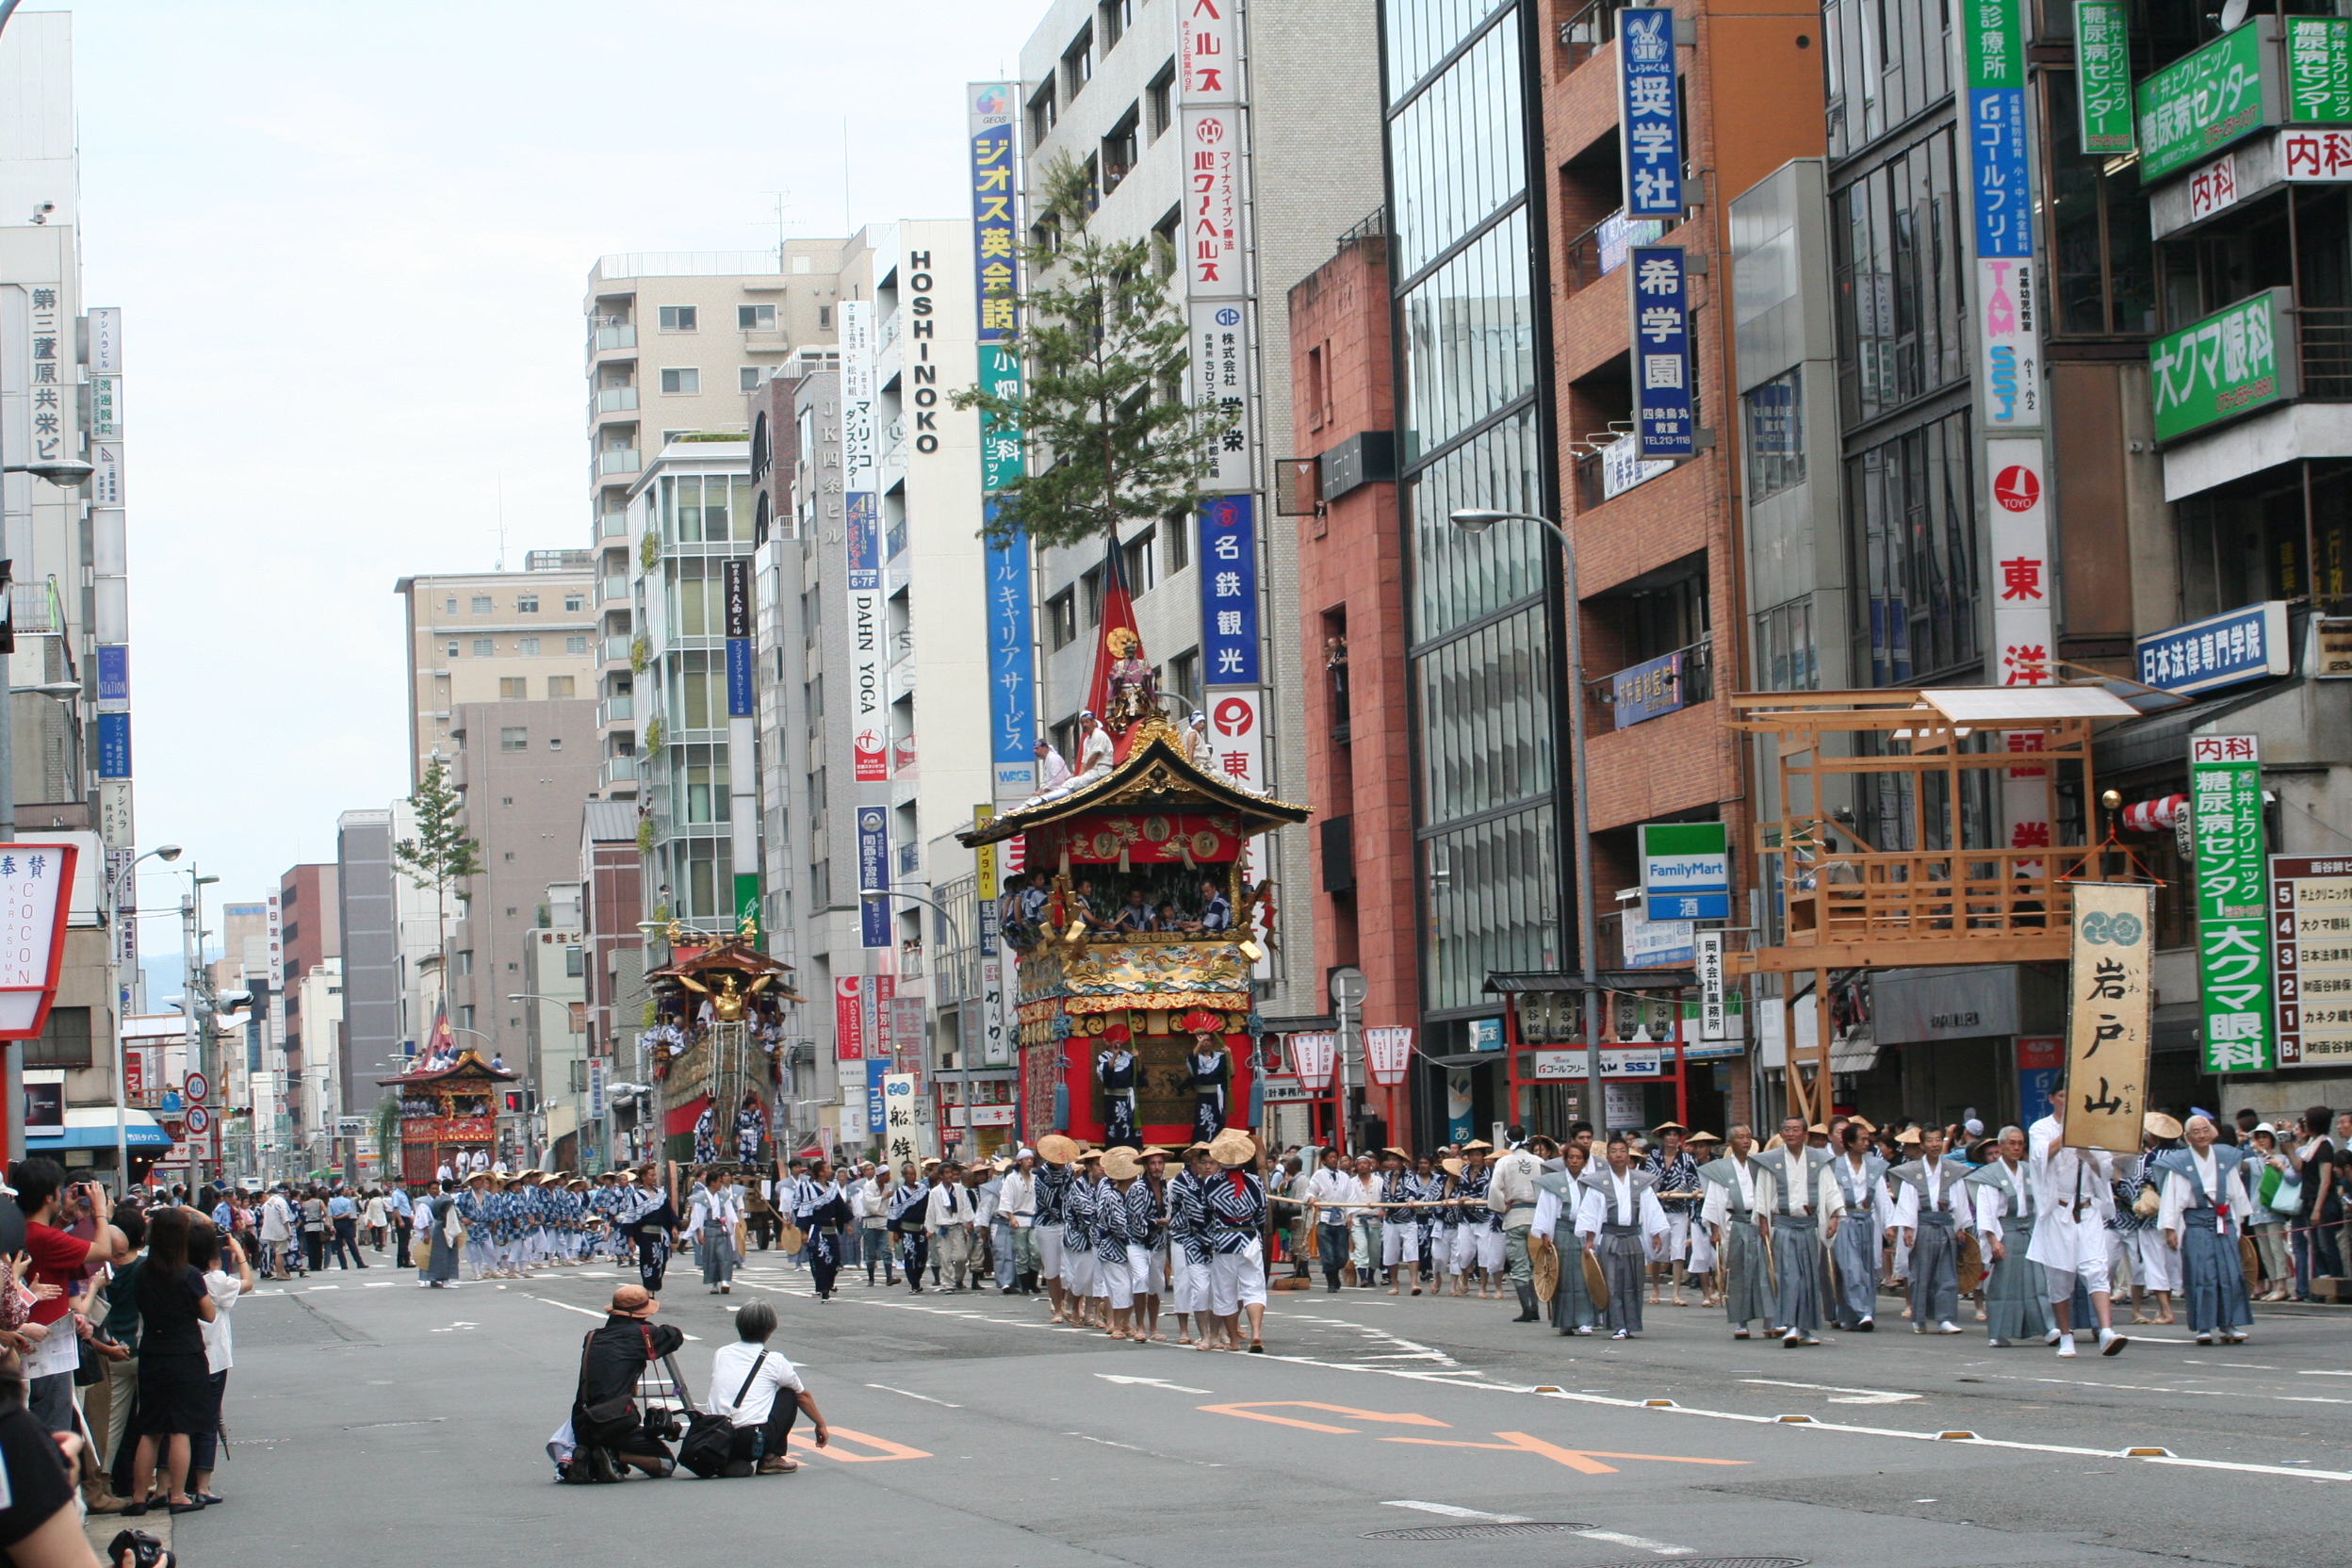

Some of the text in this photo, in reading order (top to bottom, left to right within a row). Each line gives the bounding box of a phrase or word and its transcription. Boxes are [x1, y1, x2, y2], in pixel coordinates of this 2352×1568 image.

[1980, 0, 2006, 79] 診療所
[2082, 6, 2112, 134] 糖尿病センター
[2161, 41, 2232, 101] 井上クリニック
[2293, 21, 2330, 119] 糖尿病センター
[983, 115, 1006, 124] GEOS
[2141, 62, 2259, 158] 糖尿病センター
[2286, 132, 2352, 177] 内科
[1220, 152, 1234, 250] マイナスイオン療法
[1980, 122, 2006, 253] ゴールフリー
[2191, 158, 2234, 218] 内科
[976, 139, 1015, 330] ジオス英会話
[1640, 259, 1683, 389] 希学園
[2019, 267, 2032, 332] 成基幼児教室
[100, 311, 108, 368] アシハラビル
[910, 251, 939, 454] HOSHINOKO
[1222, 333, 1236, 386] 株式会社
[2153, 299, 2274, 416] 大クマ眼科
[32, 288, 59, 476] 第三蘆原共栄ビ
[1642, 408, 1690, 420] 四条烏丸
[1656, 422, 1678, 433] 教室
[823, 402, 843, 545] JK四条ビル
[845, 409, 857, 488] ダンスシアター
[2003, 498, 2032, 509] TOYO
[1215, 535, 1244, 673] 名鉄観光
[857, 596, 875, 714] DAHN YOGA
[2144, 620, 2261, 686] 日本法律専門学院
[2195, 738, 2254, 761] 内科
[106, 804, 114, 843] 株式会社
[117, 785, 127, 829] アシハラ
[0, 856, 47, 879] 奉賛
[1650, 862, 1723, 878] FamilyMart
[2196, 771, 2237, 917] 糖尿病センター
[2236, 792, 2260, 900] 井上クリニック
[1679, 898, 1699, 917] 酒
[2278, 887, 2291, 903] 5
[2300, 919, 2350, 931] 大クマ眼科
[5, 884, 16, 986] KARASUMA
[19, 882, 34, 986] COCON
[269, 896, 280, 981] 朝日生命ビル
[983, 901, 998, 954] 駐車場
[2279, 919, 2292, 934] 4
[2280, 948, 2294, 965] 3
[850, 1000, 859, 1030] Good
[1706, 940, 1721, 1031] 岡本会計事務所
[2204, 925, 2265, 1071] 大クマ眼科
[2282, 979, 2295, 995] 2
[2082, 956, 2128, 1116] 岩戸山
[2285, 1010, 2294, 1026] 1
[189, 1081, 204, 1094] 40
[1625, 1062, 1657, 1072] SSJ
[170, 1146, 204, 1155] キザラ
